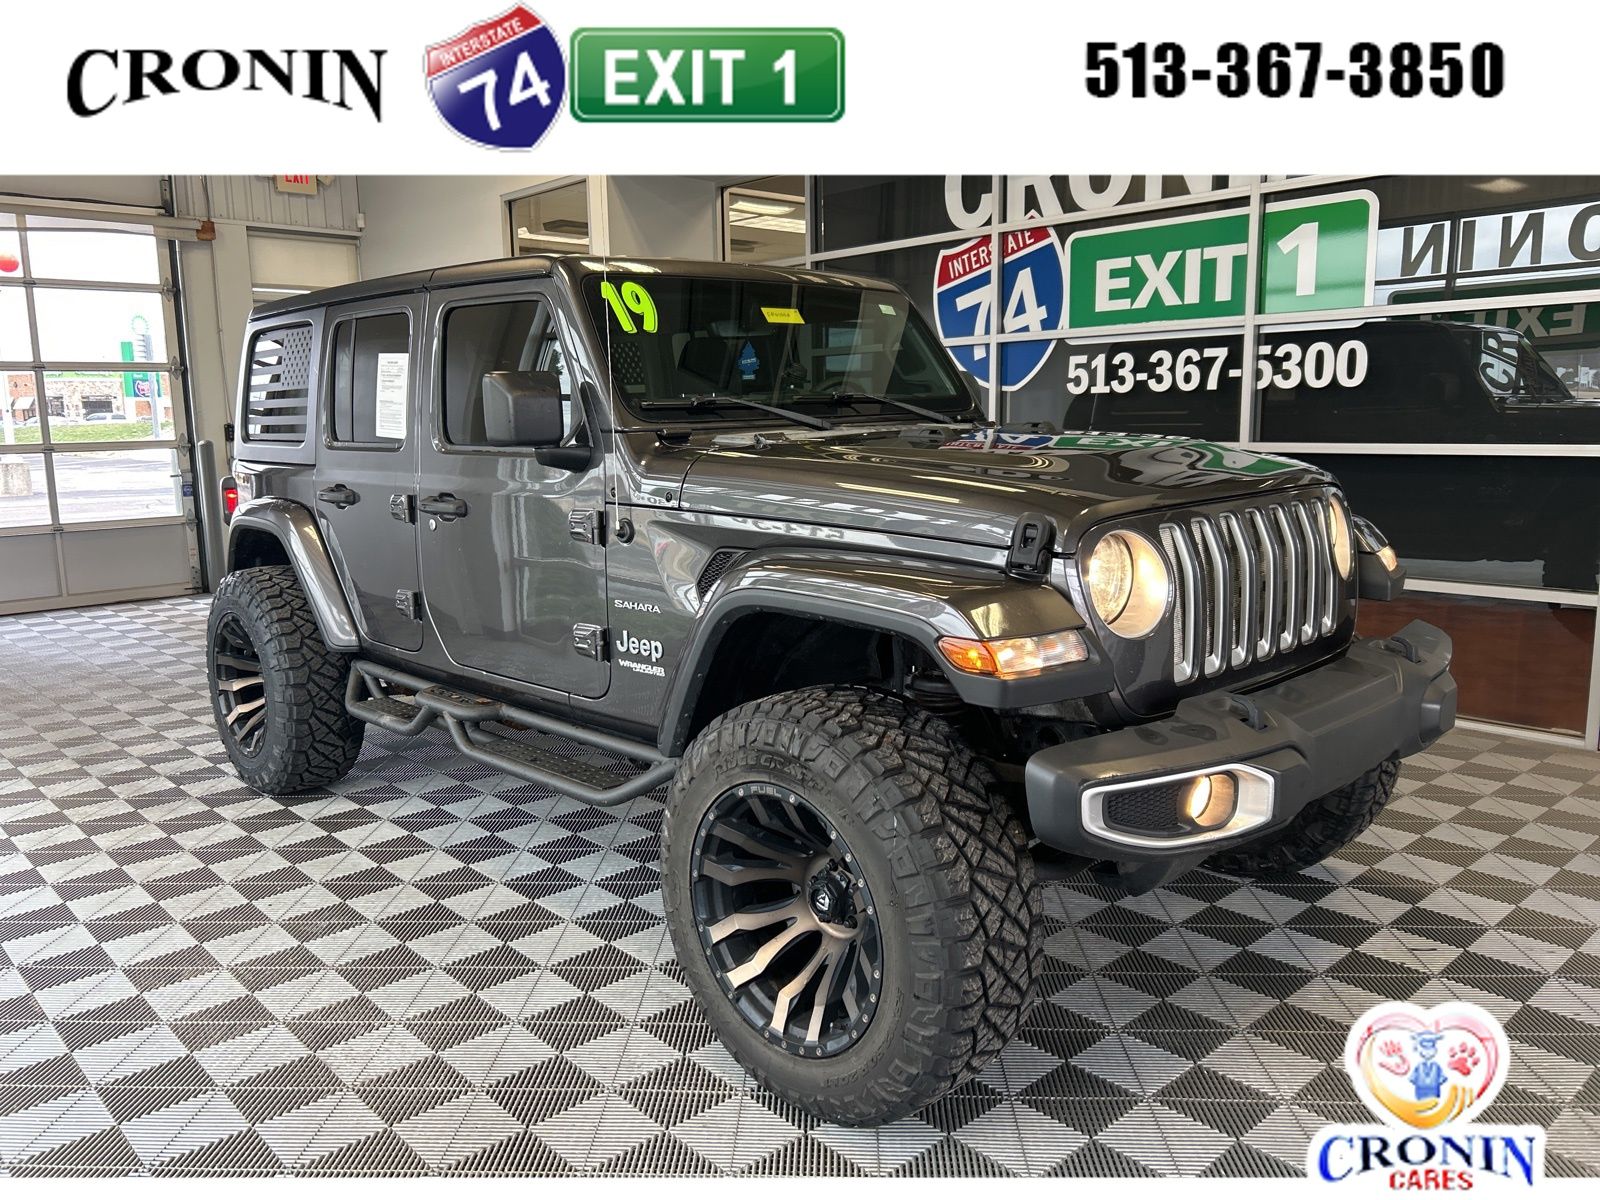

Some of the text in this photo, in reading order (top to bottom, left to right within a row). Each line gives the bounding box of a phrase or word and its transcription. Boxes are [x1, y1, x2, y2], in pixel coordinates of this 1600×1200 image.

[948, 229, 1036, 279] INTERATE
[1095, 221, 1319, 313] EXIT 1
[600, 281, 658, 334] 19
[955, 266, 1048, 361] 74
[1065, 339, 1369, 396] 513-367-5300
[614, 599, 662, 614] SAHARA
[616, 630, 664, 662] Jeep
[618, 658, 665, 672] WRANGLER
[750, 785, 782, 798] FUEL
